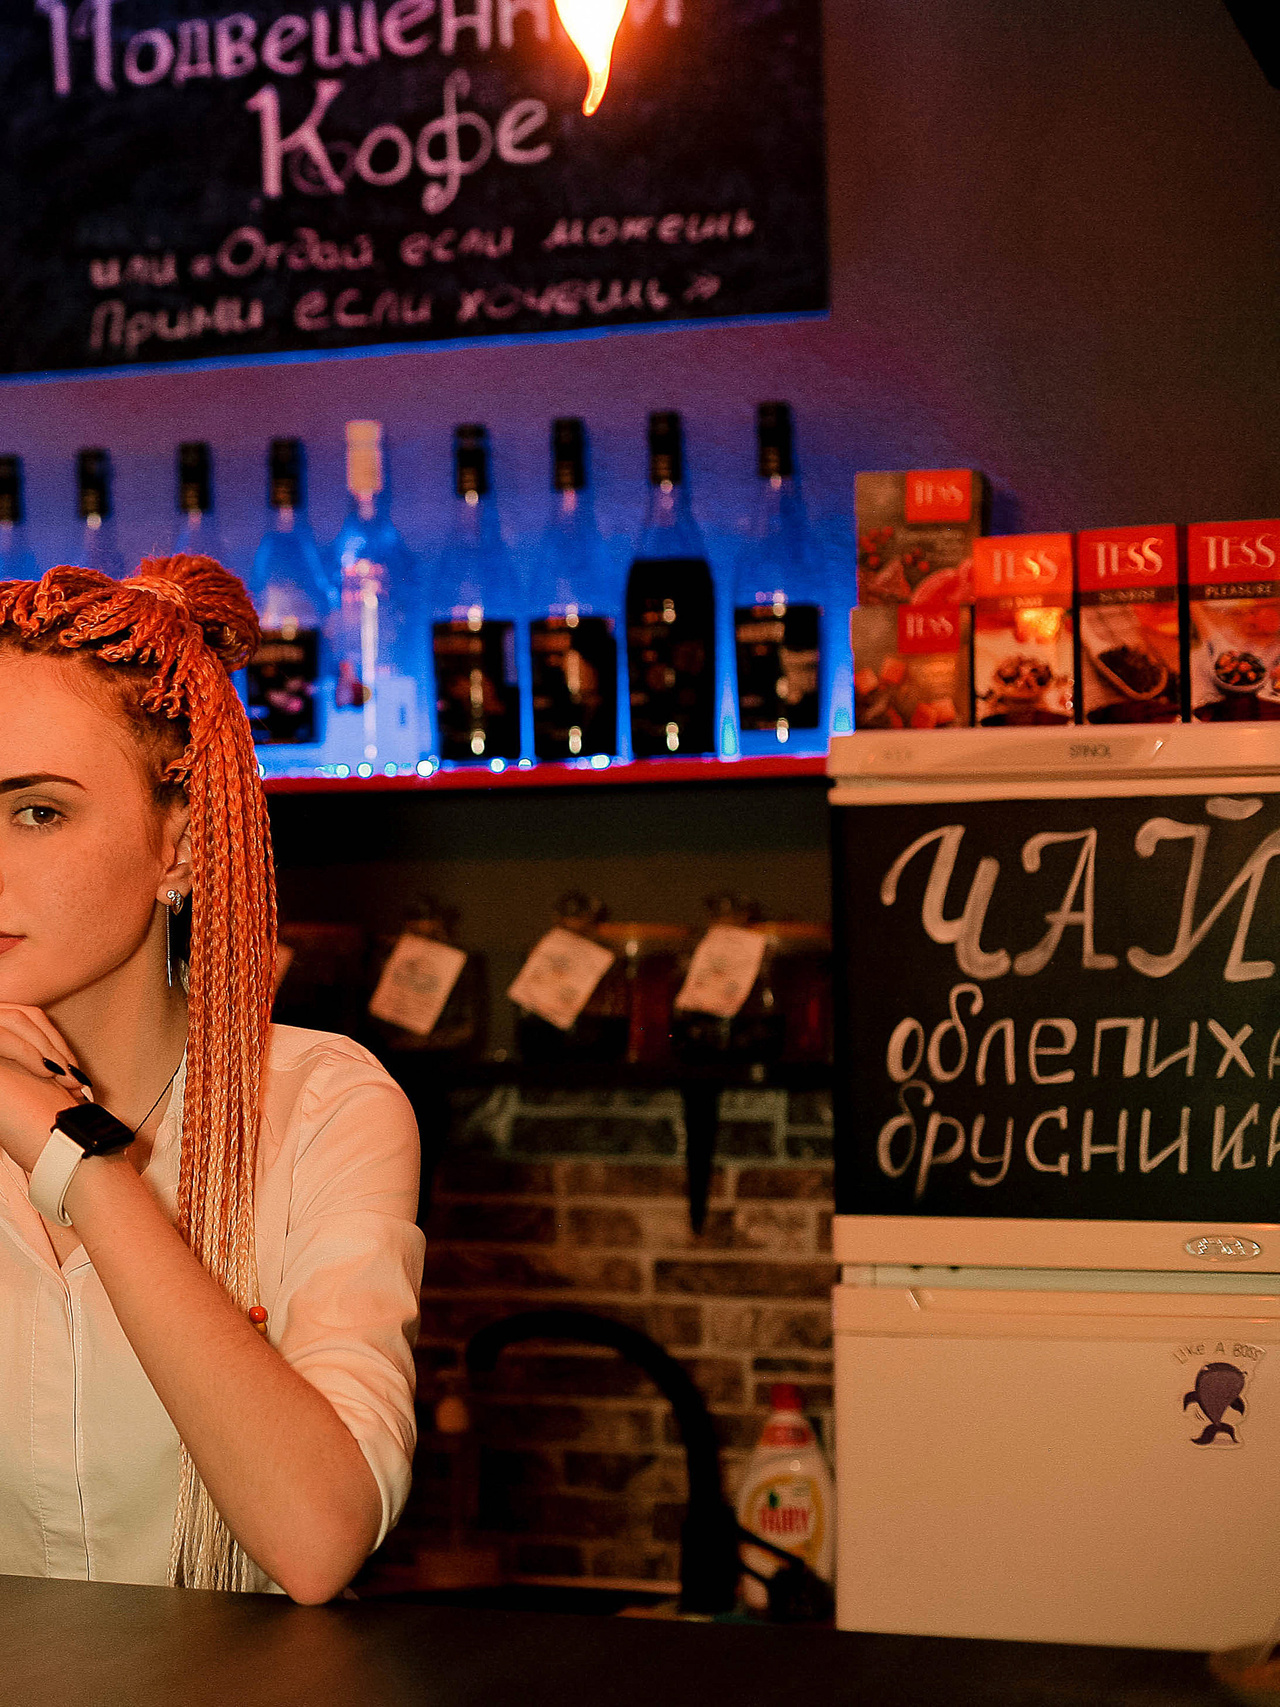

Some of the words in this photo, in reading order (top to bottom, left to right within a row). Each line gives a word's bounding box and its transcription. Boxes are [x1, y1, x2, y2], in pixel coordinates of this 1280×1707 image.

[38, 0, 683, 96] Подвешенн
[247, 69, 552, 215] Кофе
[89, 252, 176, 290] или
[399, 227, 515, 266] если
[542, 209, 755, 249] можешь
[89, 298, 263, 355] Прими
[294, 290, 433, 329] если
[991, 548, 1060, 585] TESS
[1092, 537, 1164, 579] TESS
[1201, 532, 1276, 572] TESS
[1204, 583, 1273, 598] PLEASURE
[880, 797, 1280, 982] ЧАЙ
[1173, 1343, 1205, 1365] LIKE
[1214, 1341, 1226, 1356] A
[1232, 1342, 1260, 1362] BOSS
